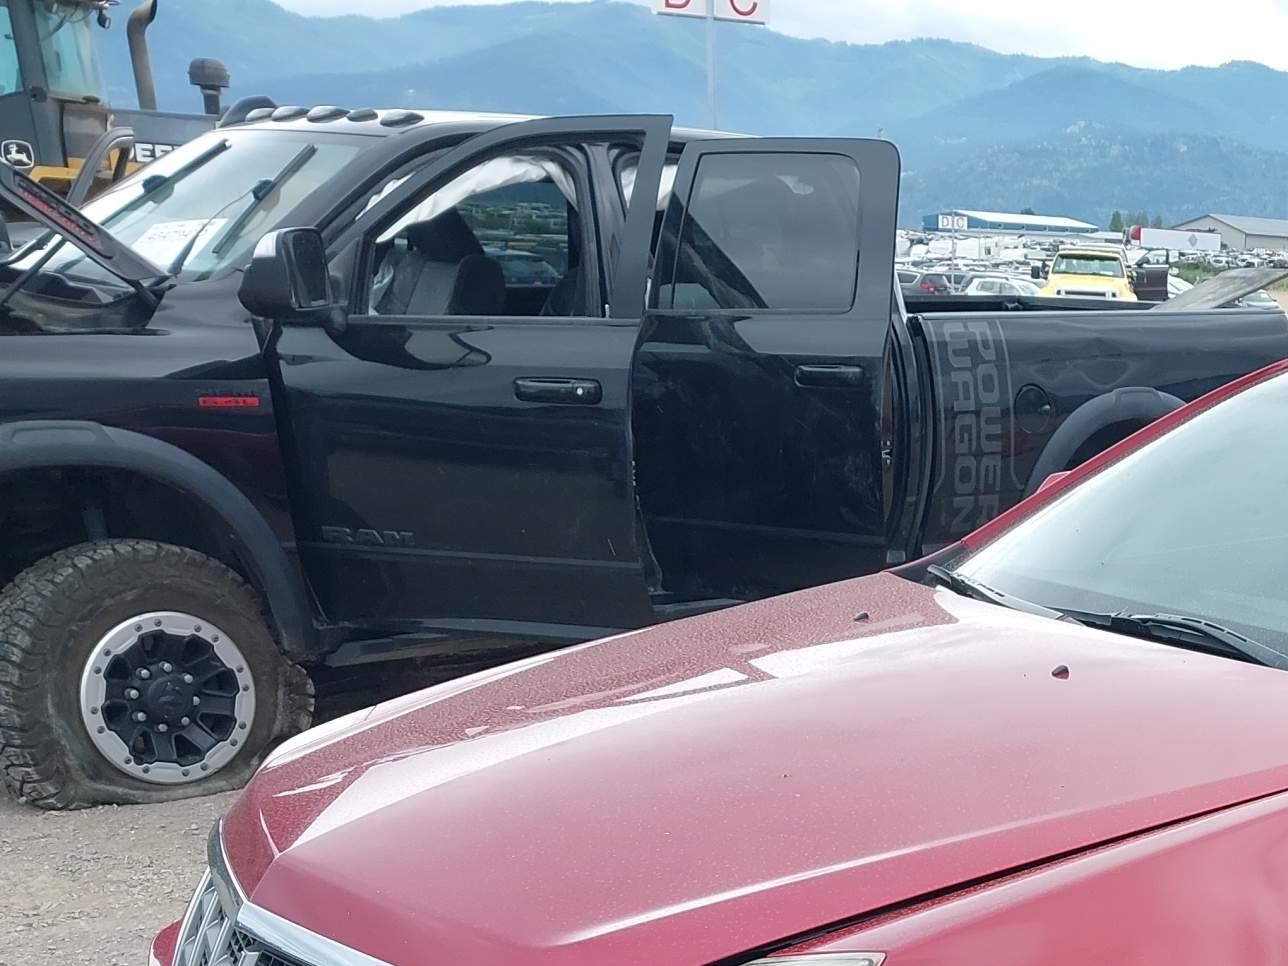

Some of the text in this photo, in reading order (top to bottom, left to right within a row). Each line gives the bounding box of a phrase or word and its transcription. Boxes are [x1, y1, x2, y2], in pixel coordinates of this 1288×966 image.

[943, 321, 977, 533] WAGON
[966, 321, 1002, 523] POWER
[321, 525, 416, 545] RAM
